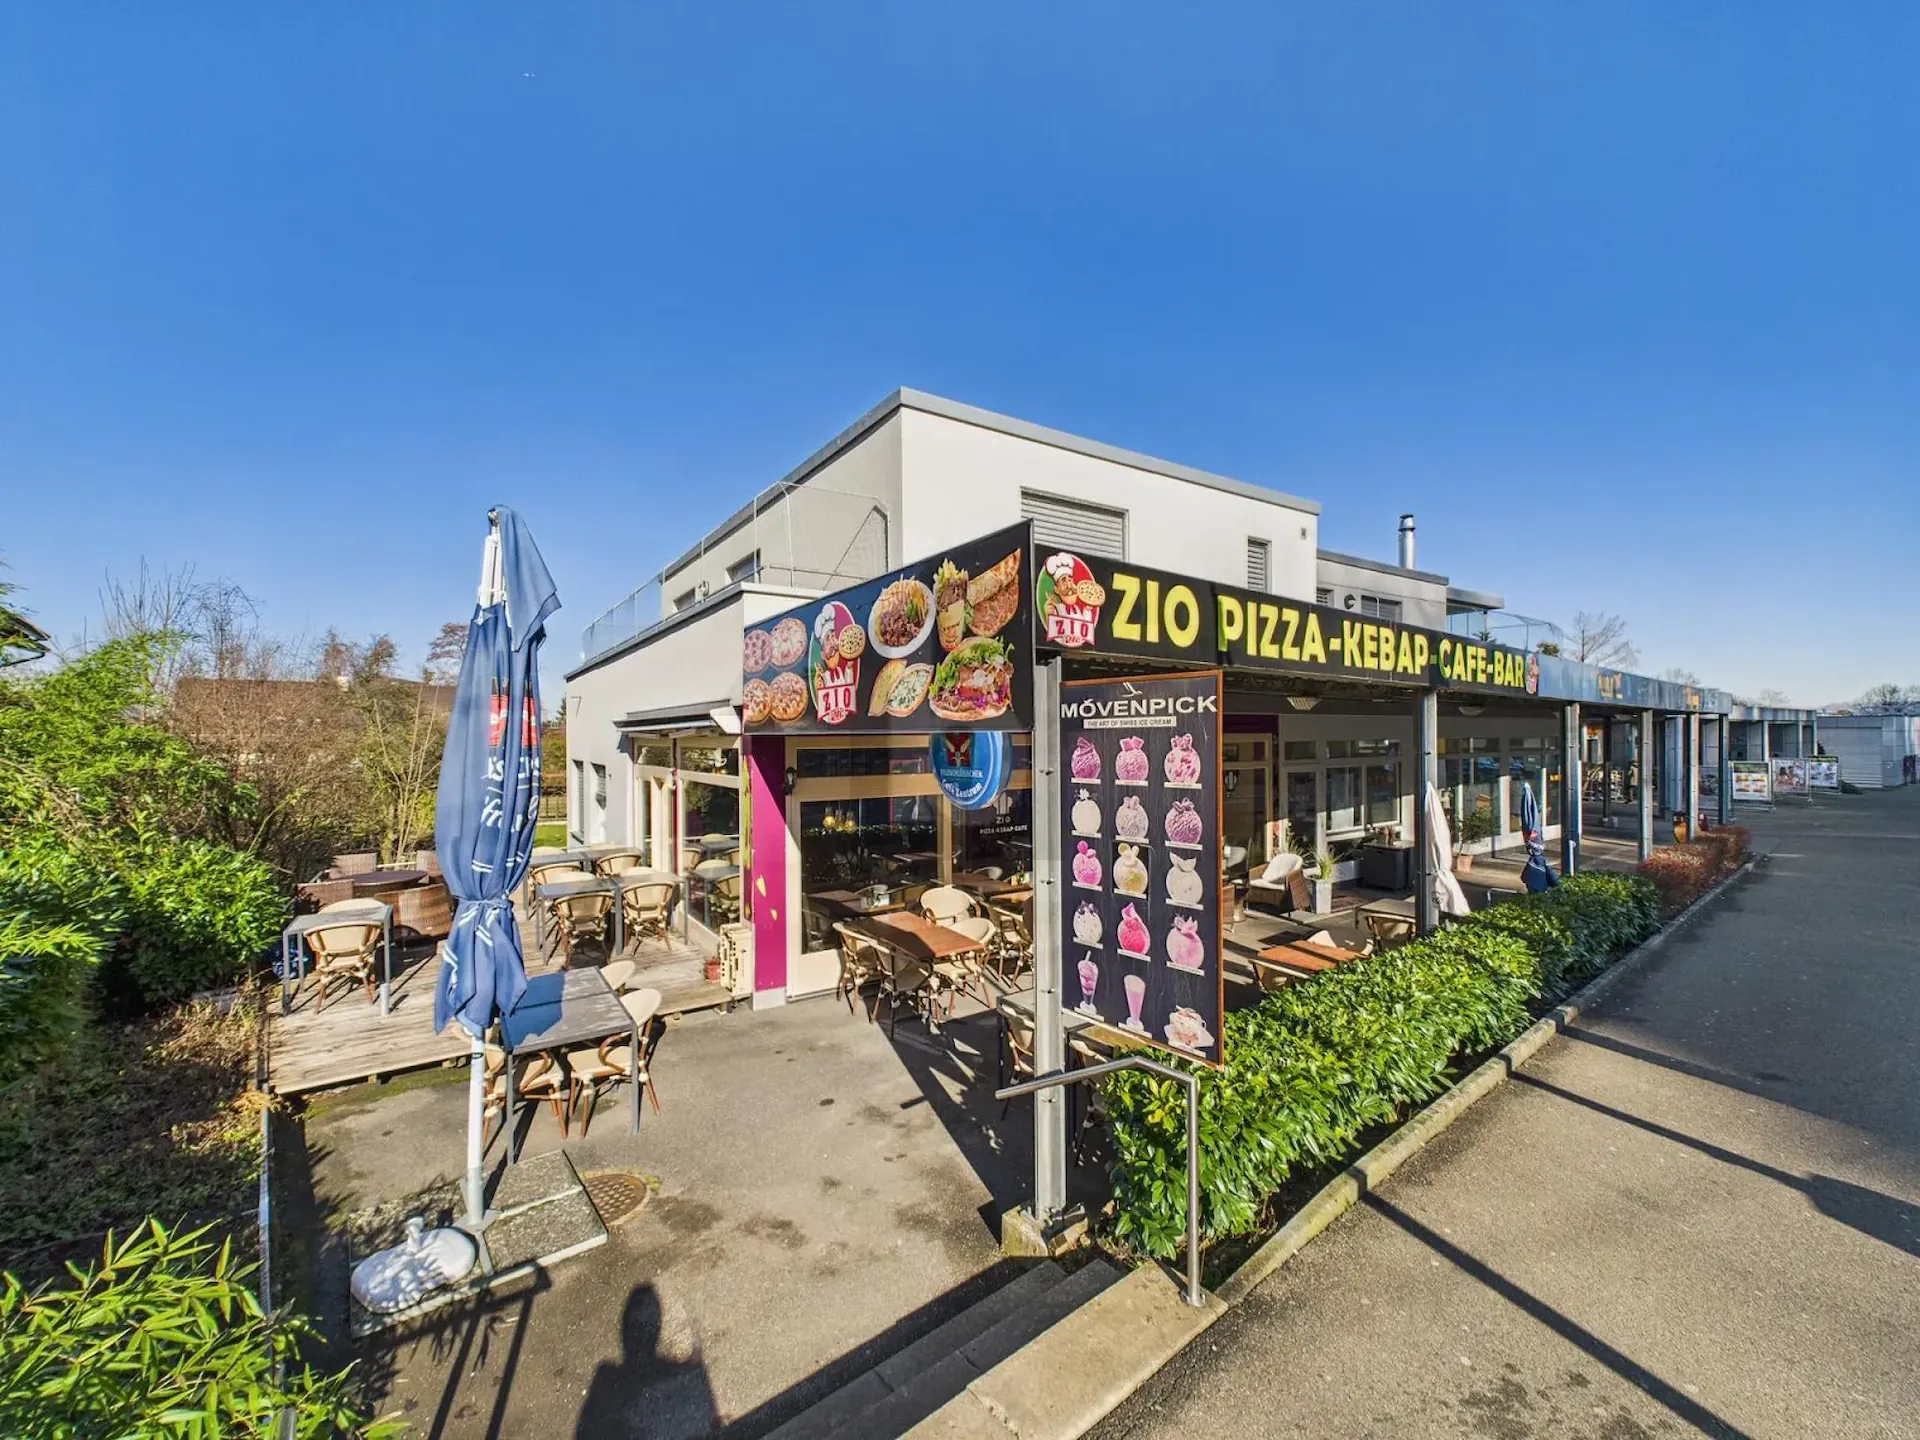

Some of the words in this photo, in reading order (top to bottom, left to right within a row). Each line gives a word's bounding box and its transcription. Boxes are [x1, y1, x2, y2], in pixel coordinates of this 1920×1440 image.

[1111, 572, 1200, 648] ZIO
[1056, 619, 1089, 637] ZIO
[823, 687, 851, 712] ZIO
[1061, 695, 1218, 719] MÖVENPICK
[995, 816, 1012, 824] ZIO
